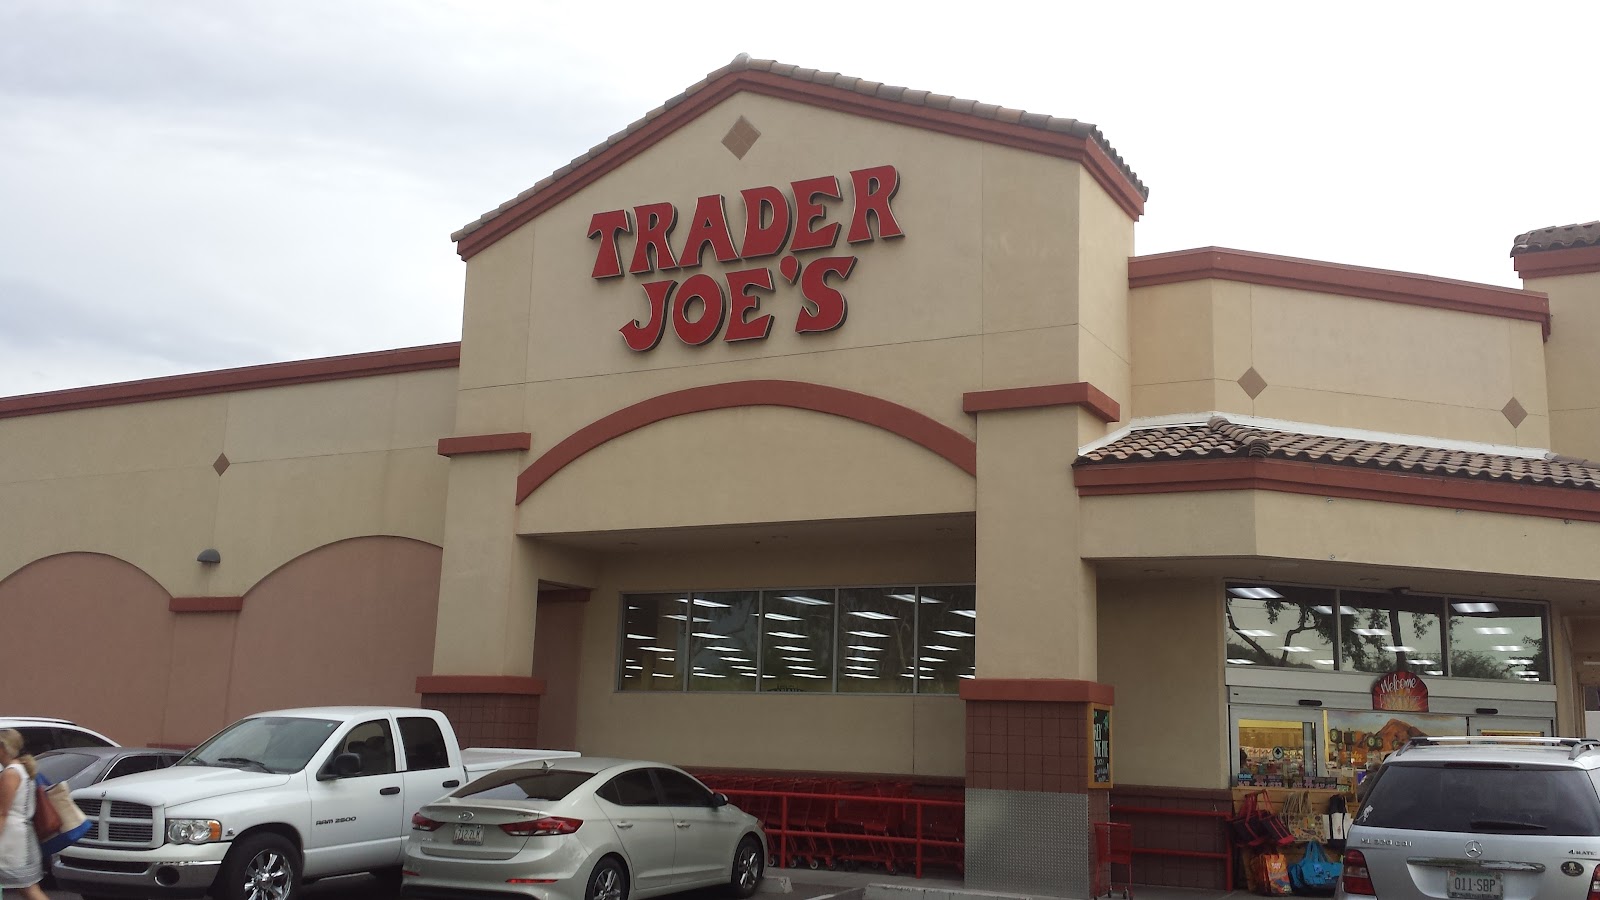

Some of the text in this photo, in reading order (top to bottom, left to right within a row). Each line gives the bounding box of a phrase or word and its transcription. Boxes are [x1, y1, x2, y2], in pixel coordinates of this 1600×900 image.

[586, 165, 904, 279] TRADER
[618, 255, 858, 353] JOE'S
[1380, 673, 1417, 694] Welcome
[315, 816, 357, 826] RAM 2500
